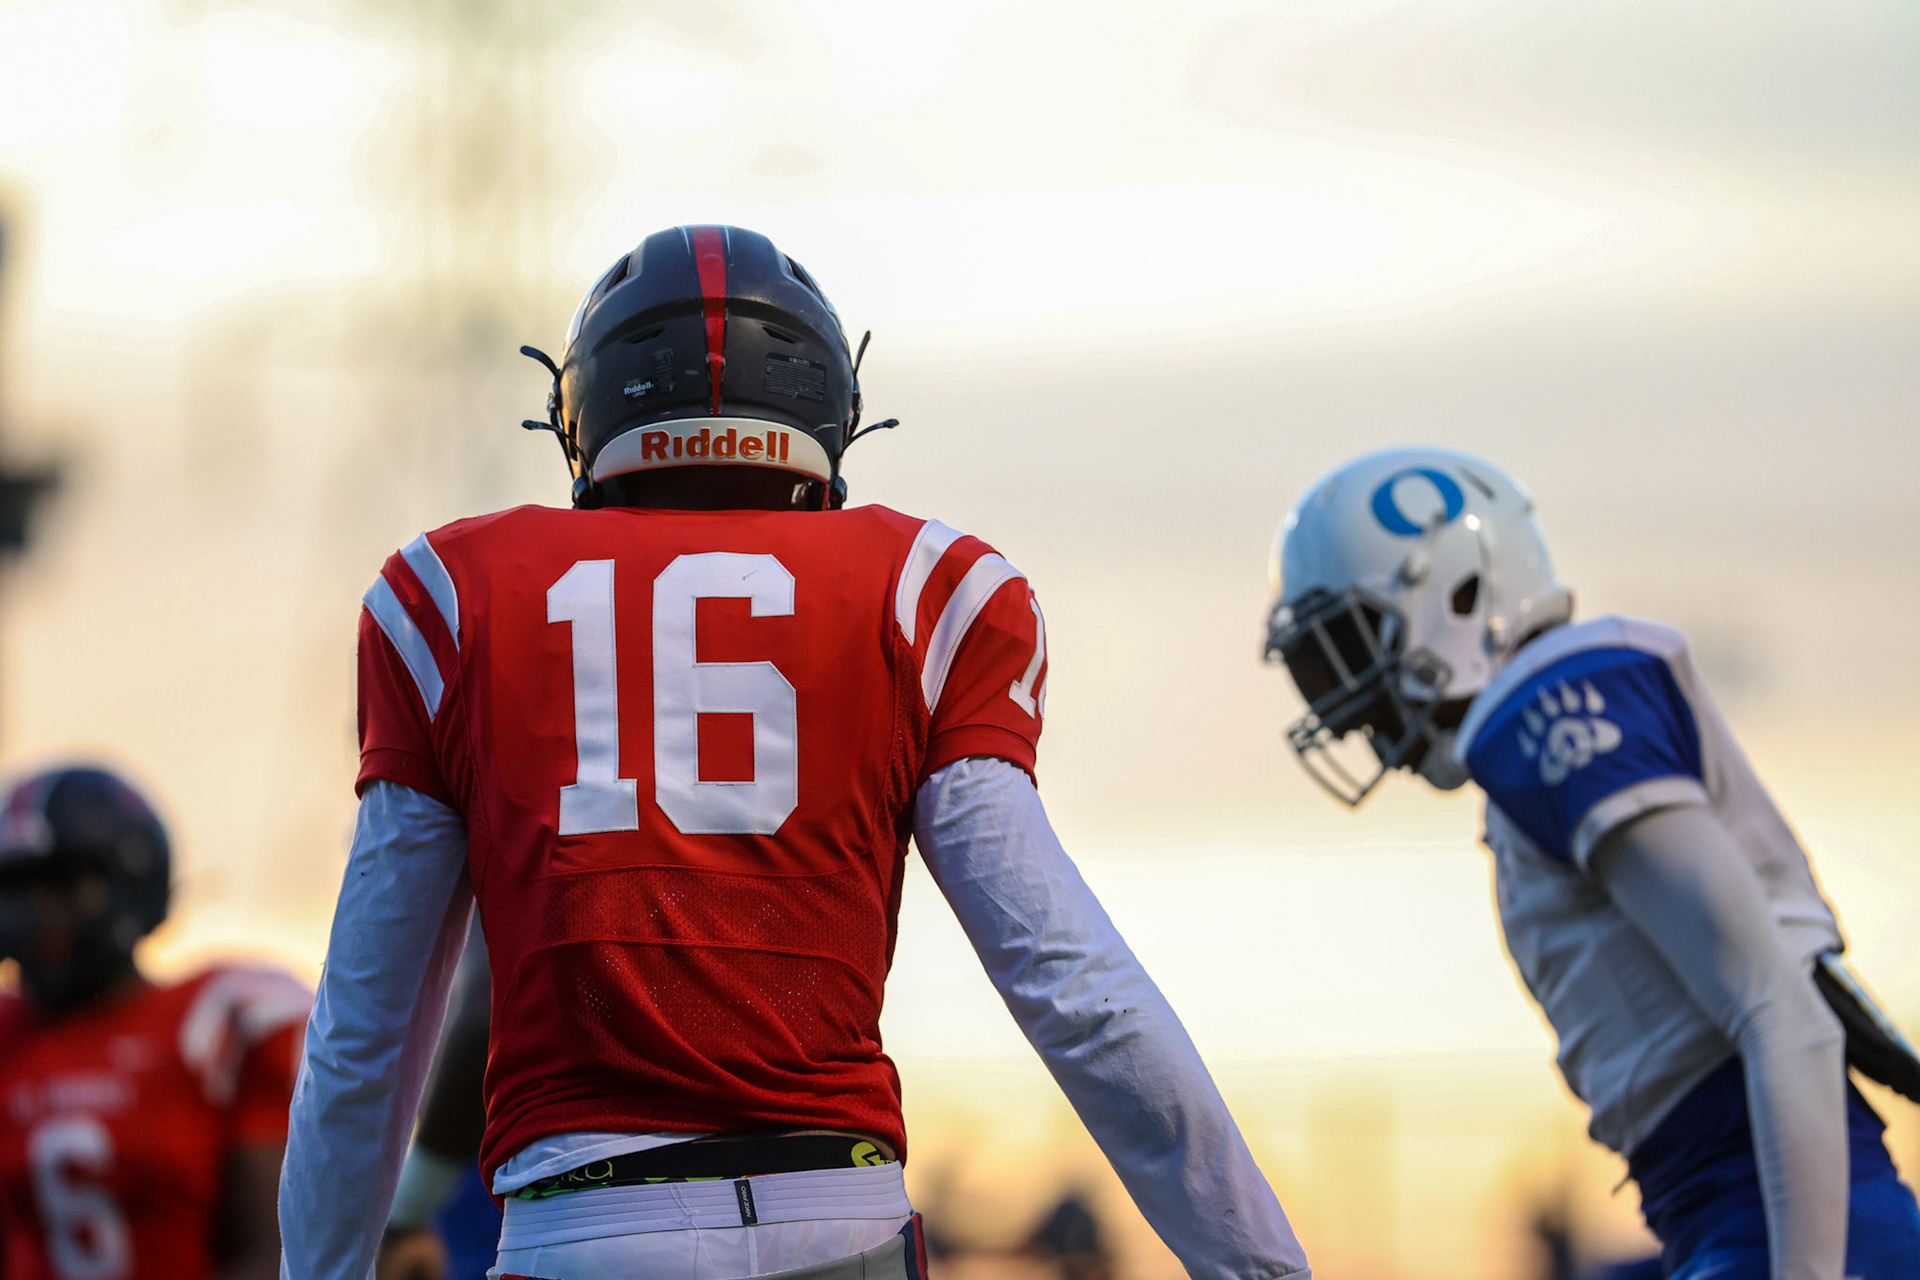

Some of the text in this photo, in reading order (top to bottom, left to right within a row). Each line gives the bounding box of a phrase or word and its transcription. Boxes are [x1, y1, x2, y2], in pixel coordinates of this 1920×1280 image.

[624, 381, 652, 395] Riddell
[640, 428, 790, 462] Riddell
[546, 551, 799, 837] 16
[1008, 597, 1048, 721] 1
[28, 1117, 134, 1280] 6
